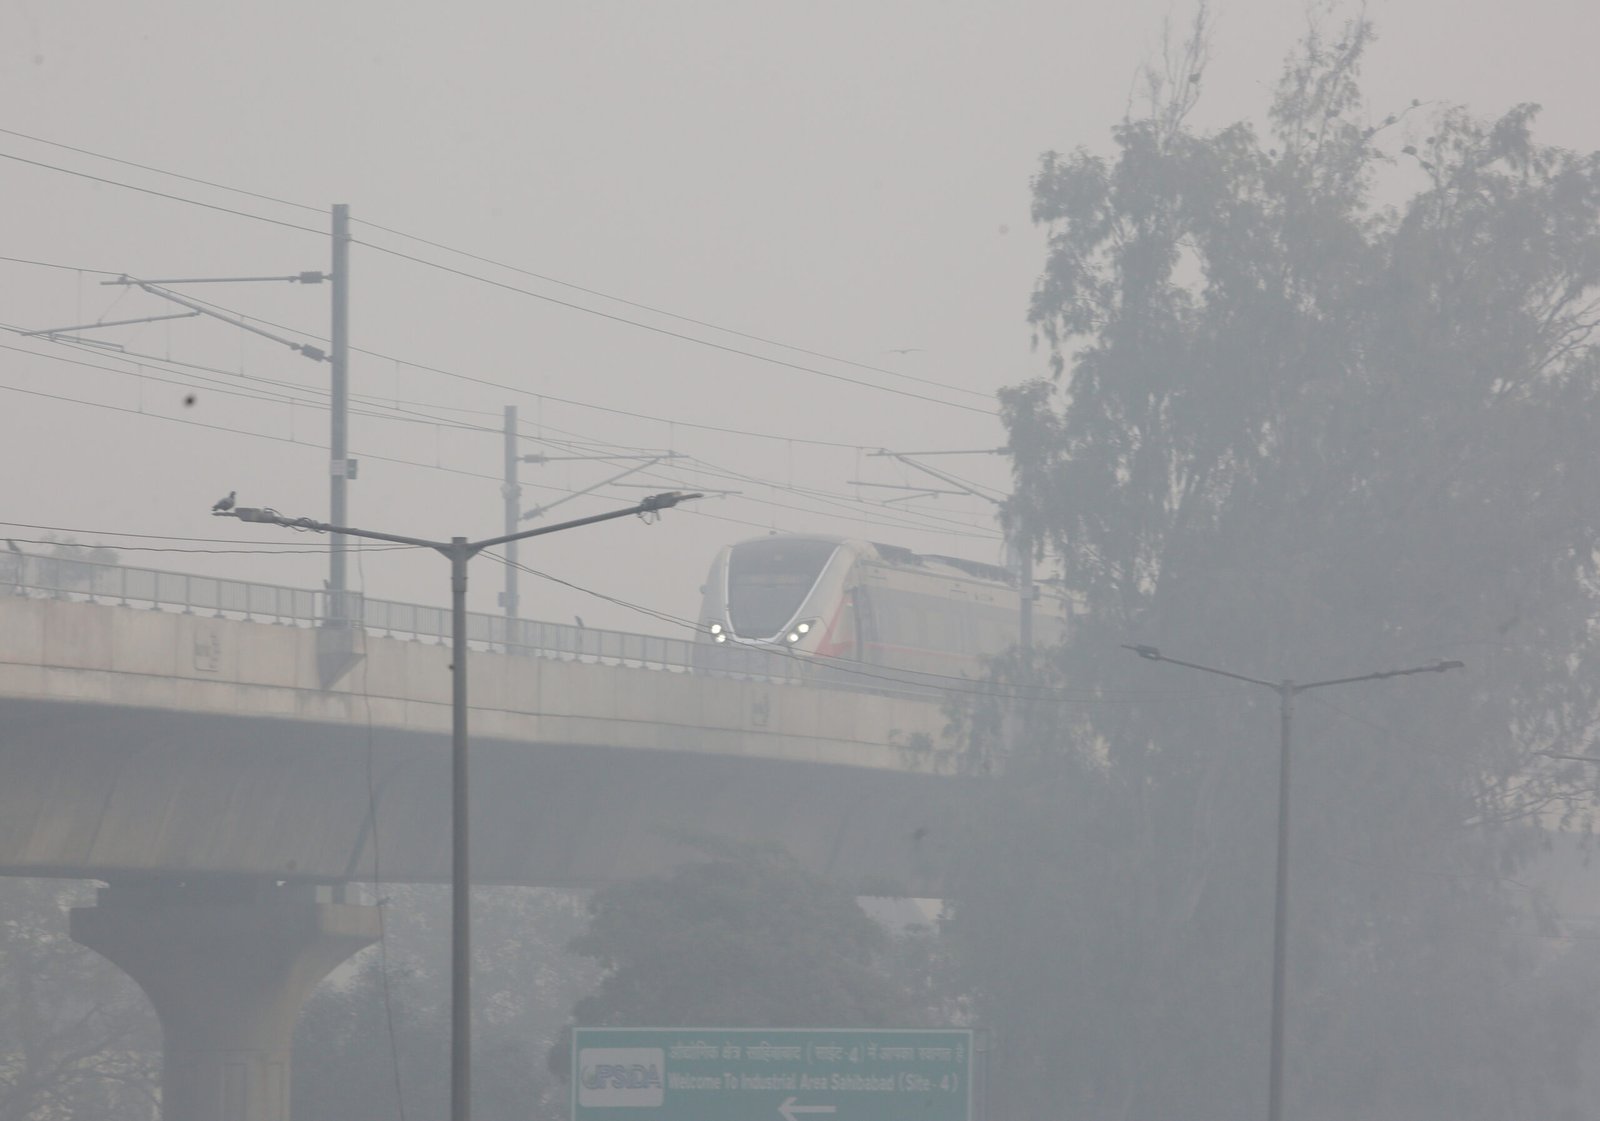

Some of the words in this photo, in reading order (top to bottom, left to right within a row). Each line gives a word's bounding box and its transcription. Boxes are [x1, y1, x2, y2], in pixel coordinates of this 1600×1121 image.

[667, 1071, 721, 1090] Welcome
[723, 1072, 739, 1090] To
[740, 1072, 797, 1091] Industrial
[799, 1072, 828, 1091] Area
[831, 1072, 895, 1091] Sahibabad
